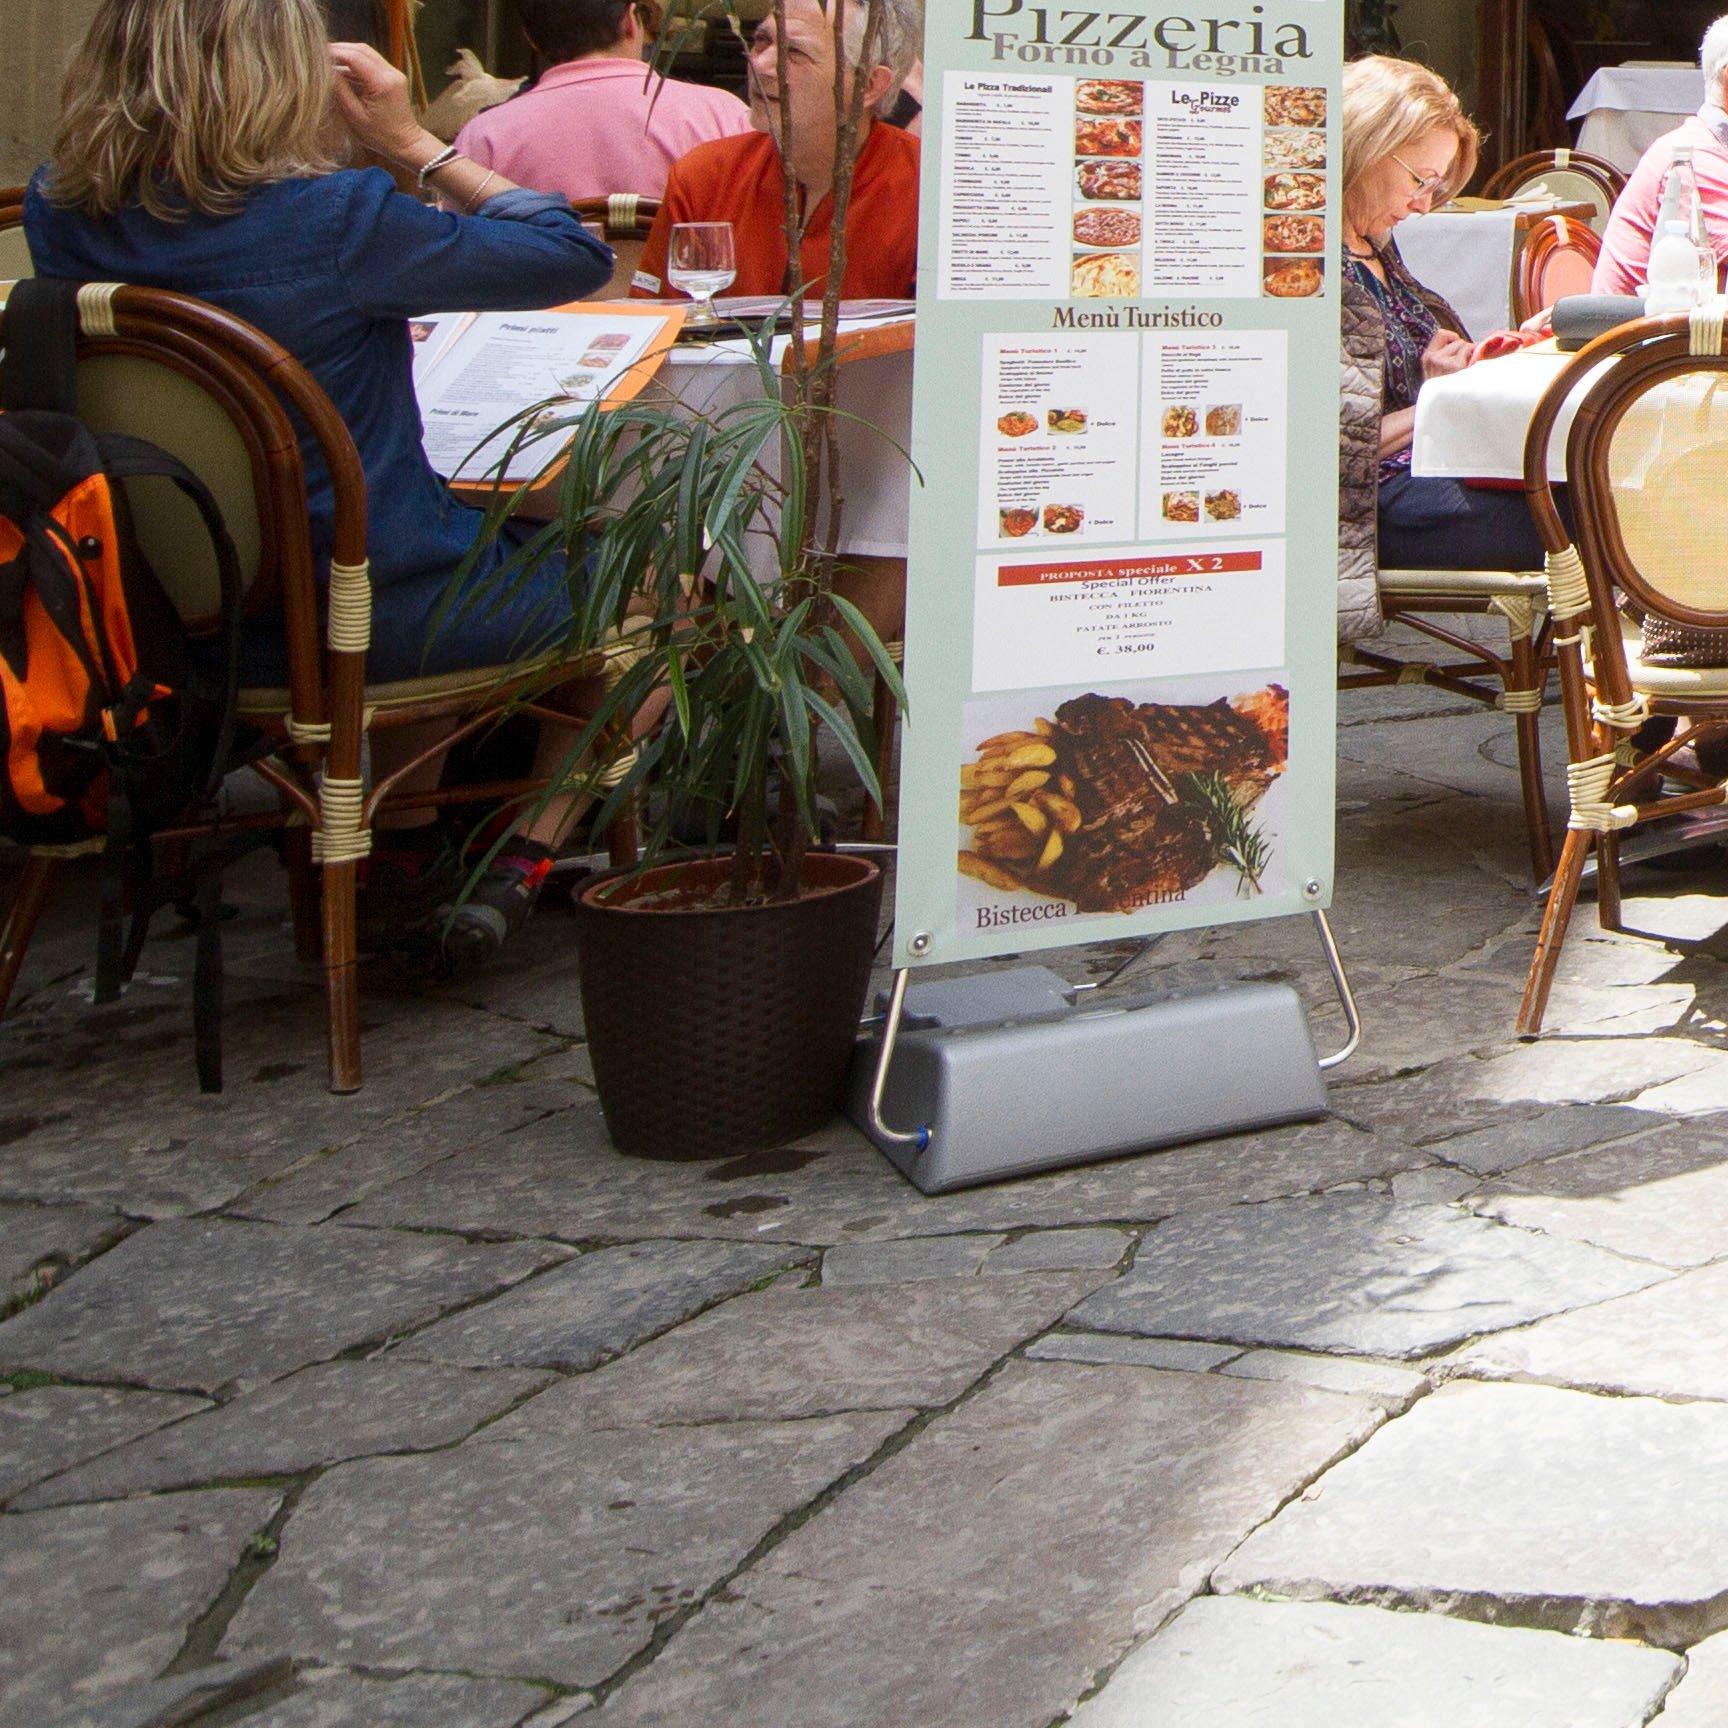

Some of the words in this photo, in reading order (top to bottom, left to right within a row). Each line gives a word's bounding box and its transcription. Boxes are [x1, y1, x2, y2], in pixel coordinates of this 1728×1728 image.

[991, 32, 1115, 67] Forno
[1129, 51, 1151, 68] a
[1165, 41, 1286, 76] Legna
[1172, 90, 1190, 104] Le
[1200, 91, 1240, 107] Pizze
[1052, 305, 1119, 329] Menù
[1122, 305, 1224, 328] Turistico
[1040, 569, 1114, 582] PROPOSTA
[1118, 563, 1178, 577] speciale
[1187, 558, 1205, 571] X
[1211, 557, 1224, 570] 2
[1081, 578, 1133, 591] Special
[1138, 576, 1176, 586] Offer
[1050, 591, 1118, 602] BISTECCA
[1130, 585, 1213, 597] FIORENTINA
[1117, 600, 1164, 609] FILETTO
[1076, 624, 1119, 633] PATATE
[1122, 620, 1173, 630] ARROSTO
[1115, 642, 1155, 655] 38,00
[976, 902, 1067, 929] Bistecca
